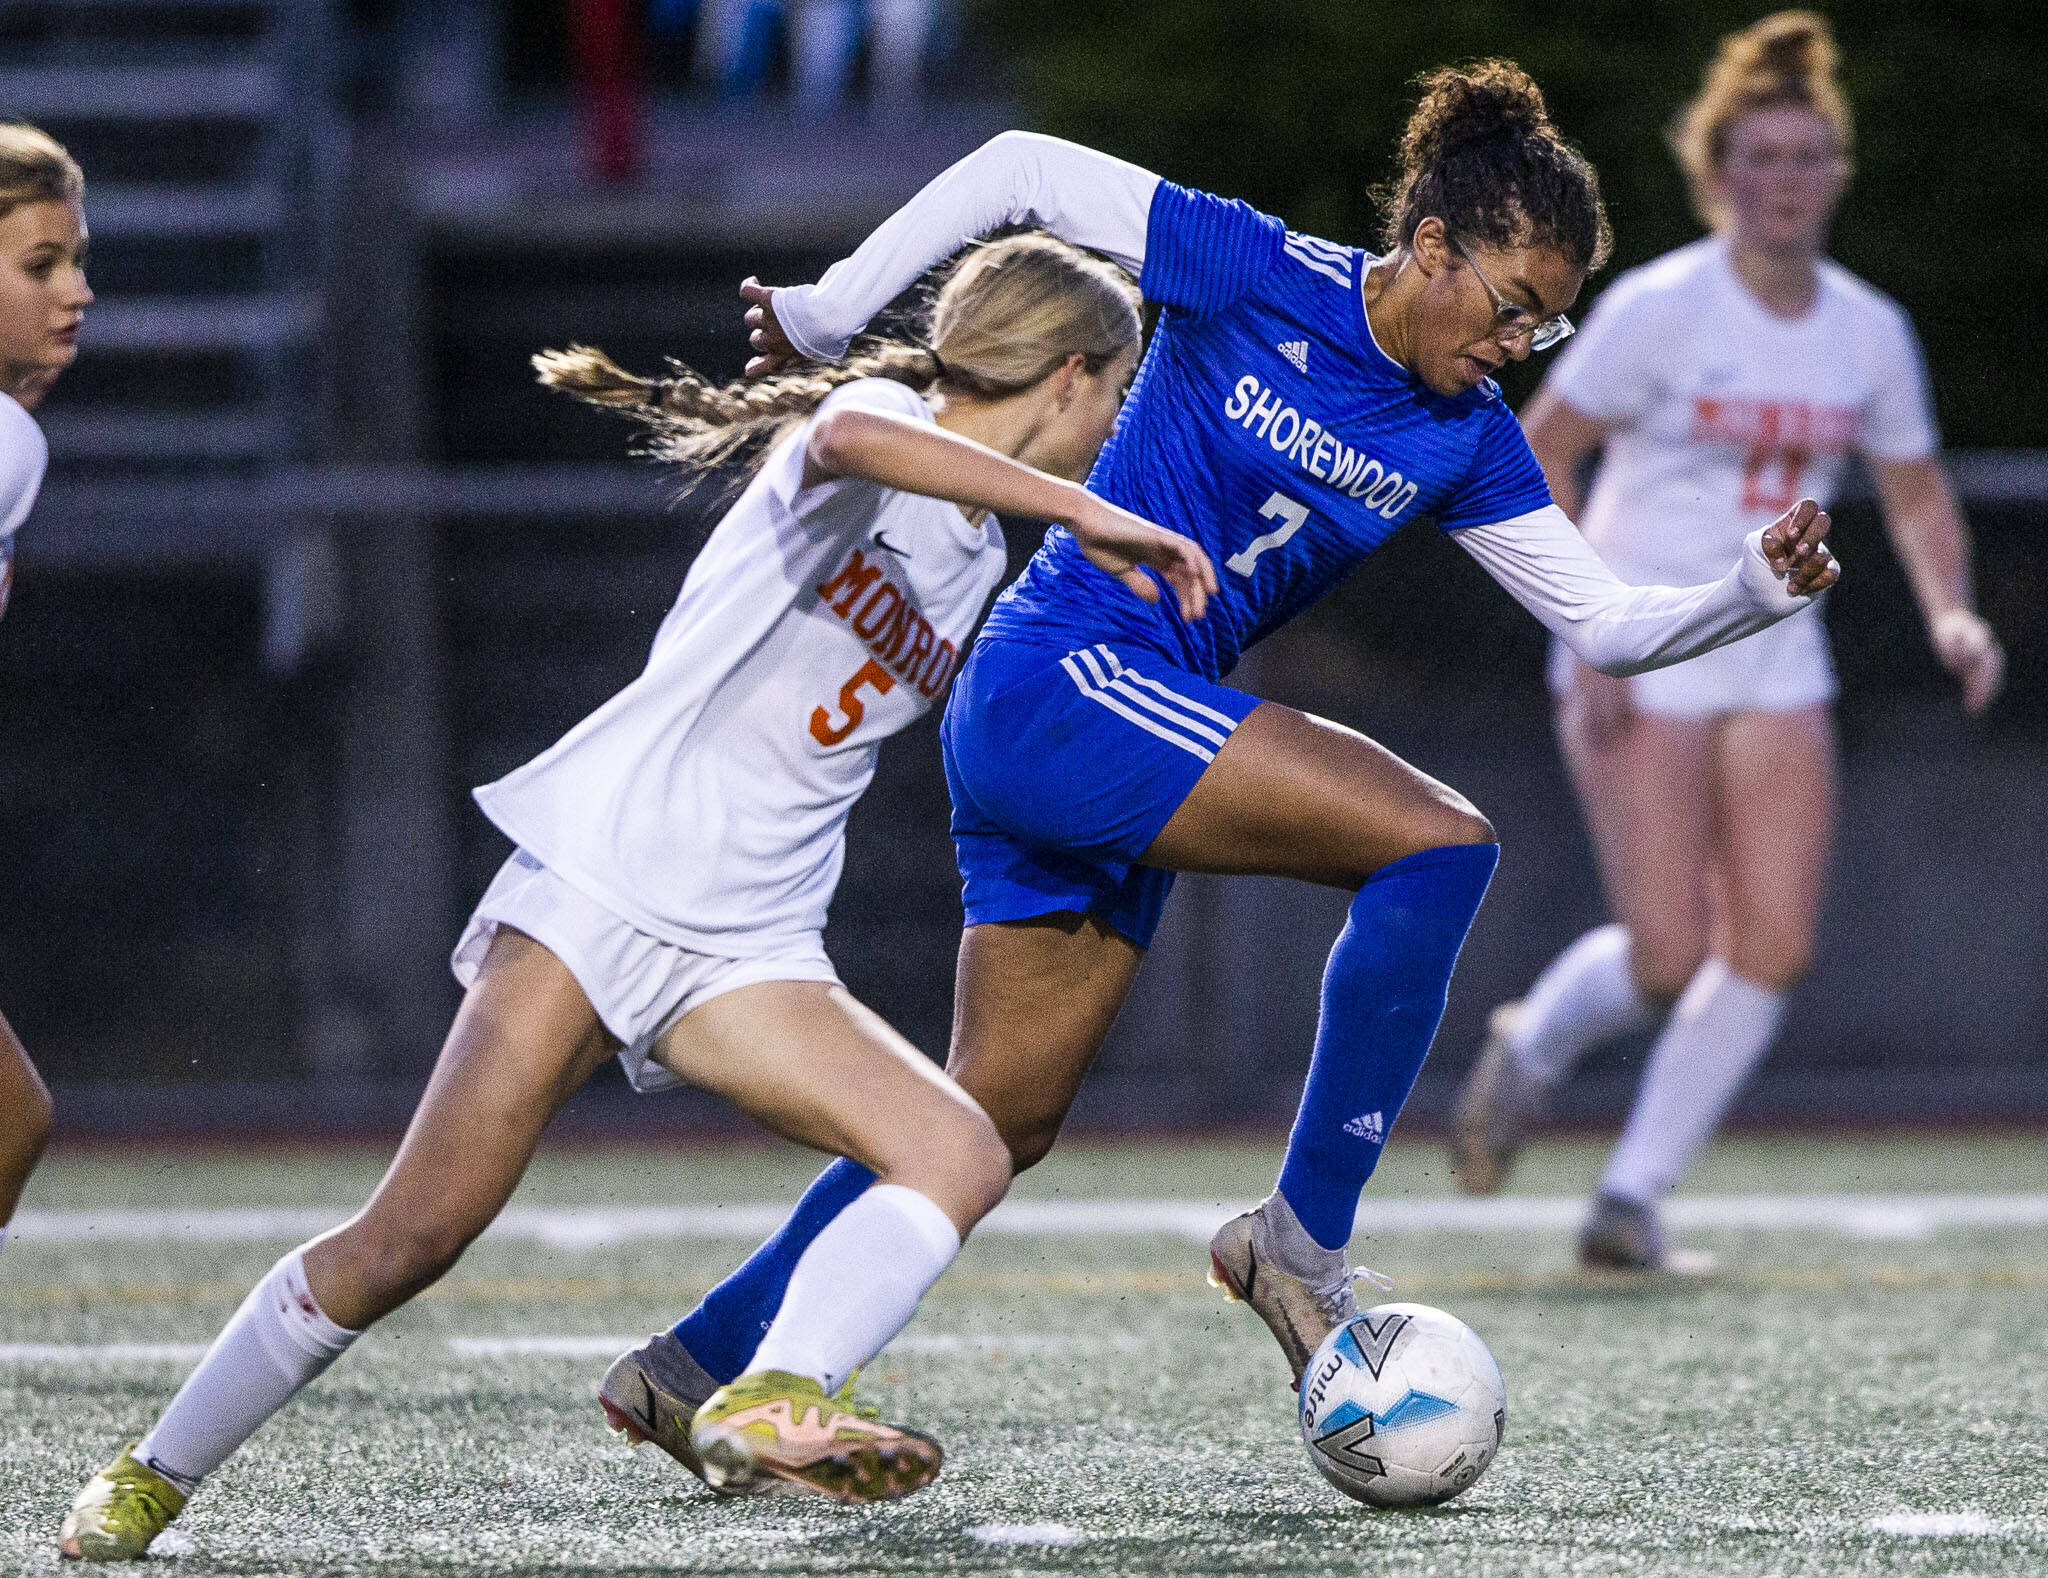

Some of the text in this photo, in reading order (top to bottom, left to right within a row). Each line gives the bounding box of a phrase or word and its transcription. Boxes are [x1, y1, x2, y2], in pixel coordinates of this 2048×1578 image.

[1277, 343, 1307, 373] adidas
[1225, 375, 1418, 519] SHOREWOOD
[1225, 491, 1310, 577] 7
[817, 550, 957, 702] MONRO
[809, 658, 895, 747] 5
[1342, 1123, 1384, 1144] adidas
[1305, 1354, 1343, 1428] mitre
